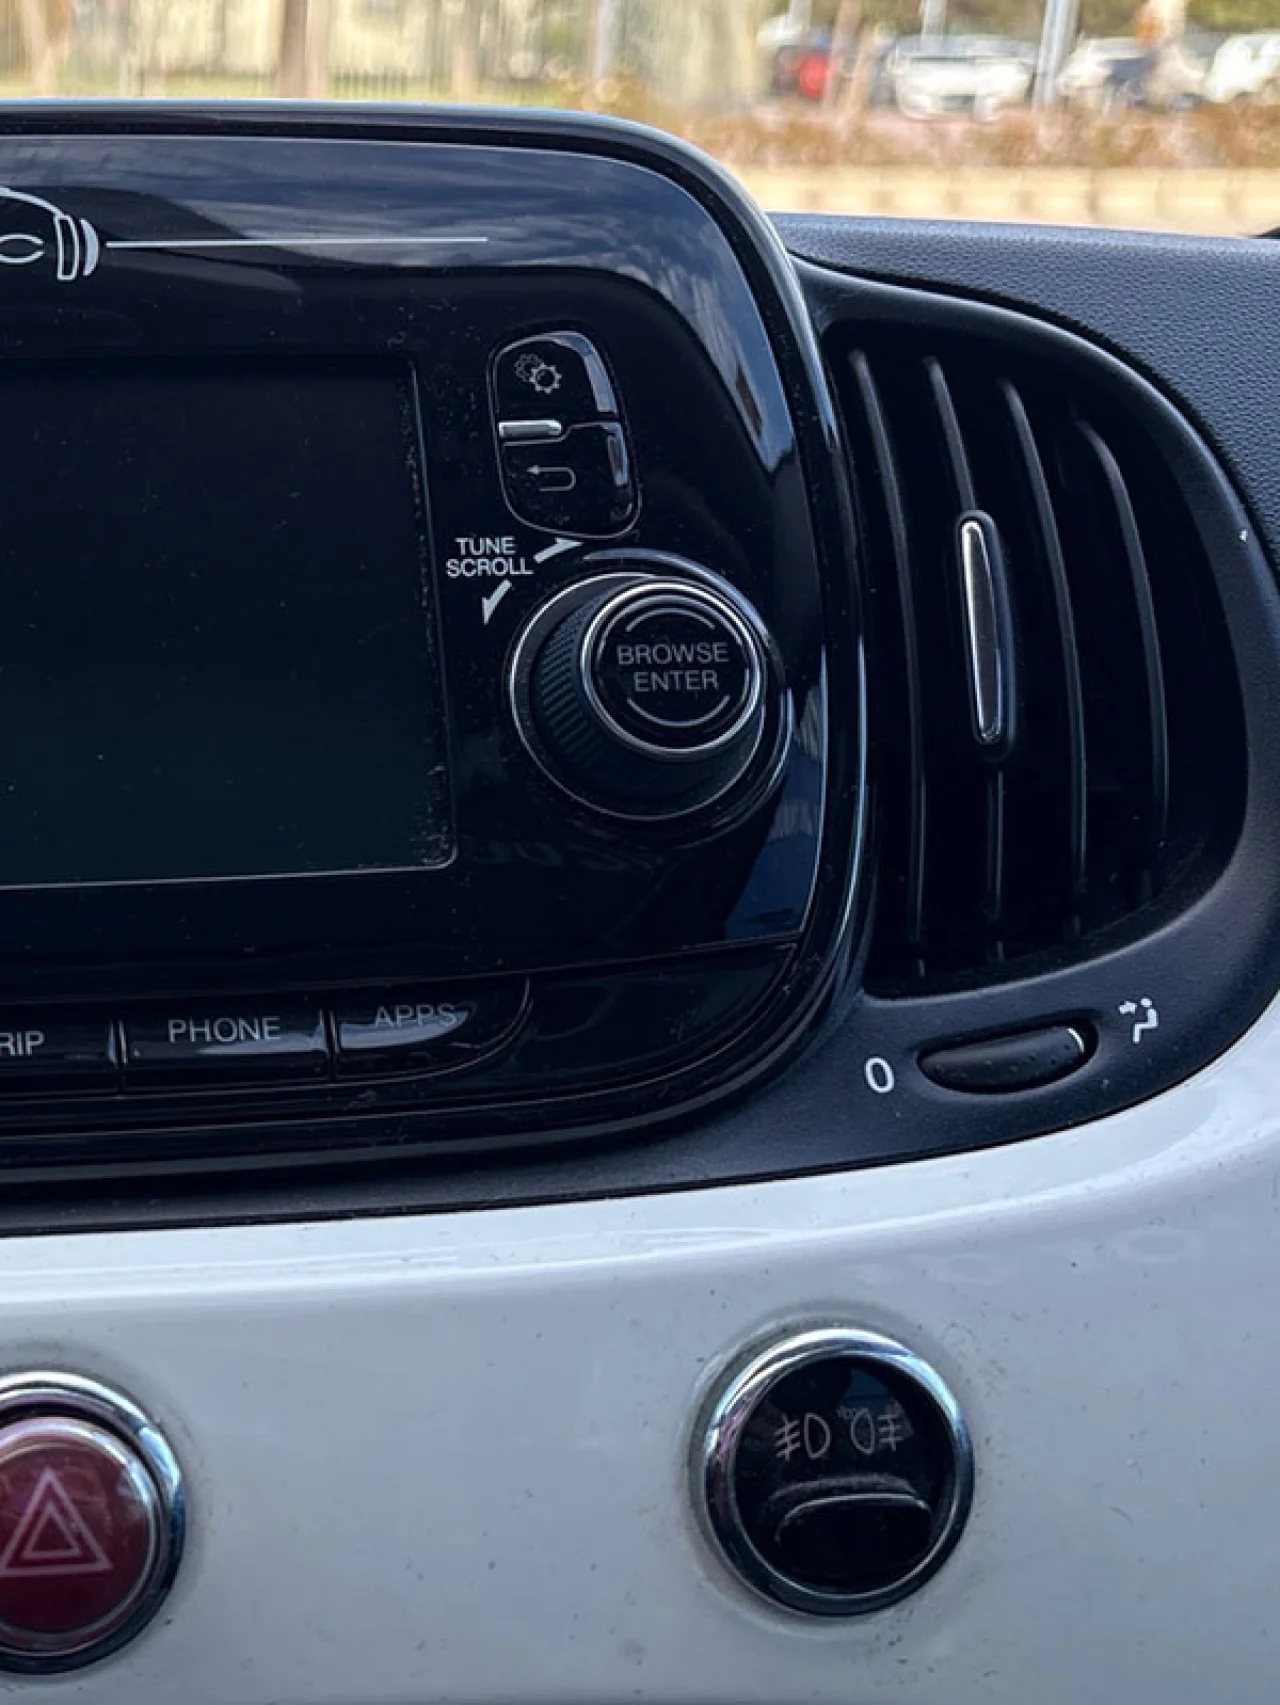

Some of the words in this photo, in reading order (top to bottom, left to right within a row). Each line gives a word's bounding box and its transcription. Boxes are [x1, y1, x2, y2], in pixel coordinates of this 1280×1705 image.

[454, 536, 516, 556] TUNE
[445, 558, 533, 577] SCROLL
[616, 642, 730, 666] BROWSE
[633, 670, 720, 692] ENTER
[373, 1003, 458, 1028] APPS
[168, 1016, 280, 1042] PHONE
